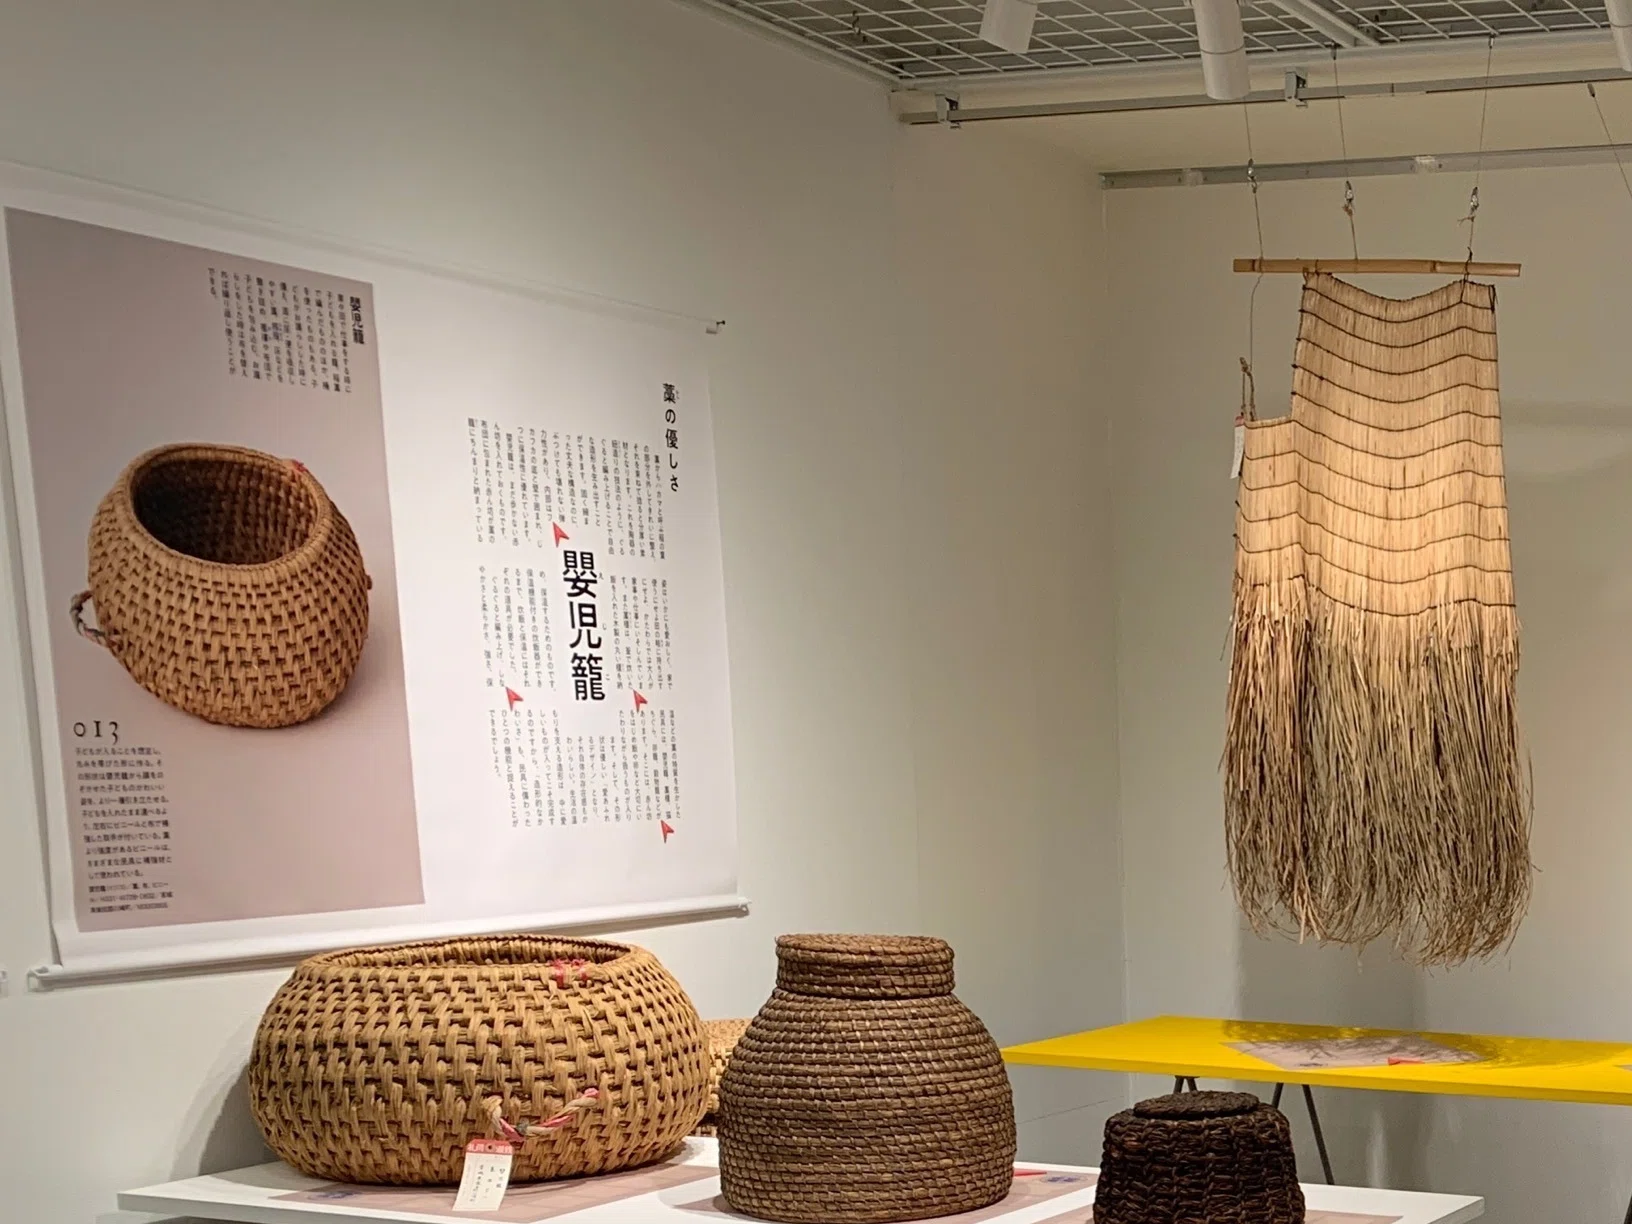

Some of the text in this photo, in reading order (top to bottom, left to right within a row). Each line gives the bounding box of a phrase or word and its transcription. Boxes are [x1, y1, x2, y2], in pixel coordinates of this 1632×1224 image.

[351, 297, 364, 344] 嬰児籠
[663, 383, 678, 492] 藁の優しさ
[563, 550, 606, 701] 嬰児籠
[74, 720, 120, 744] 013
